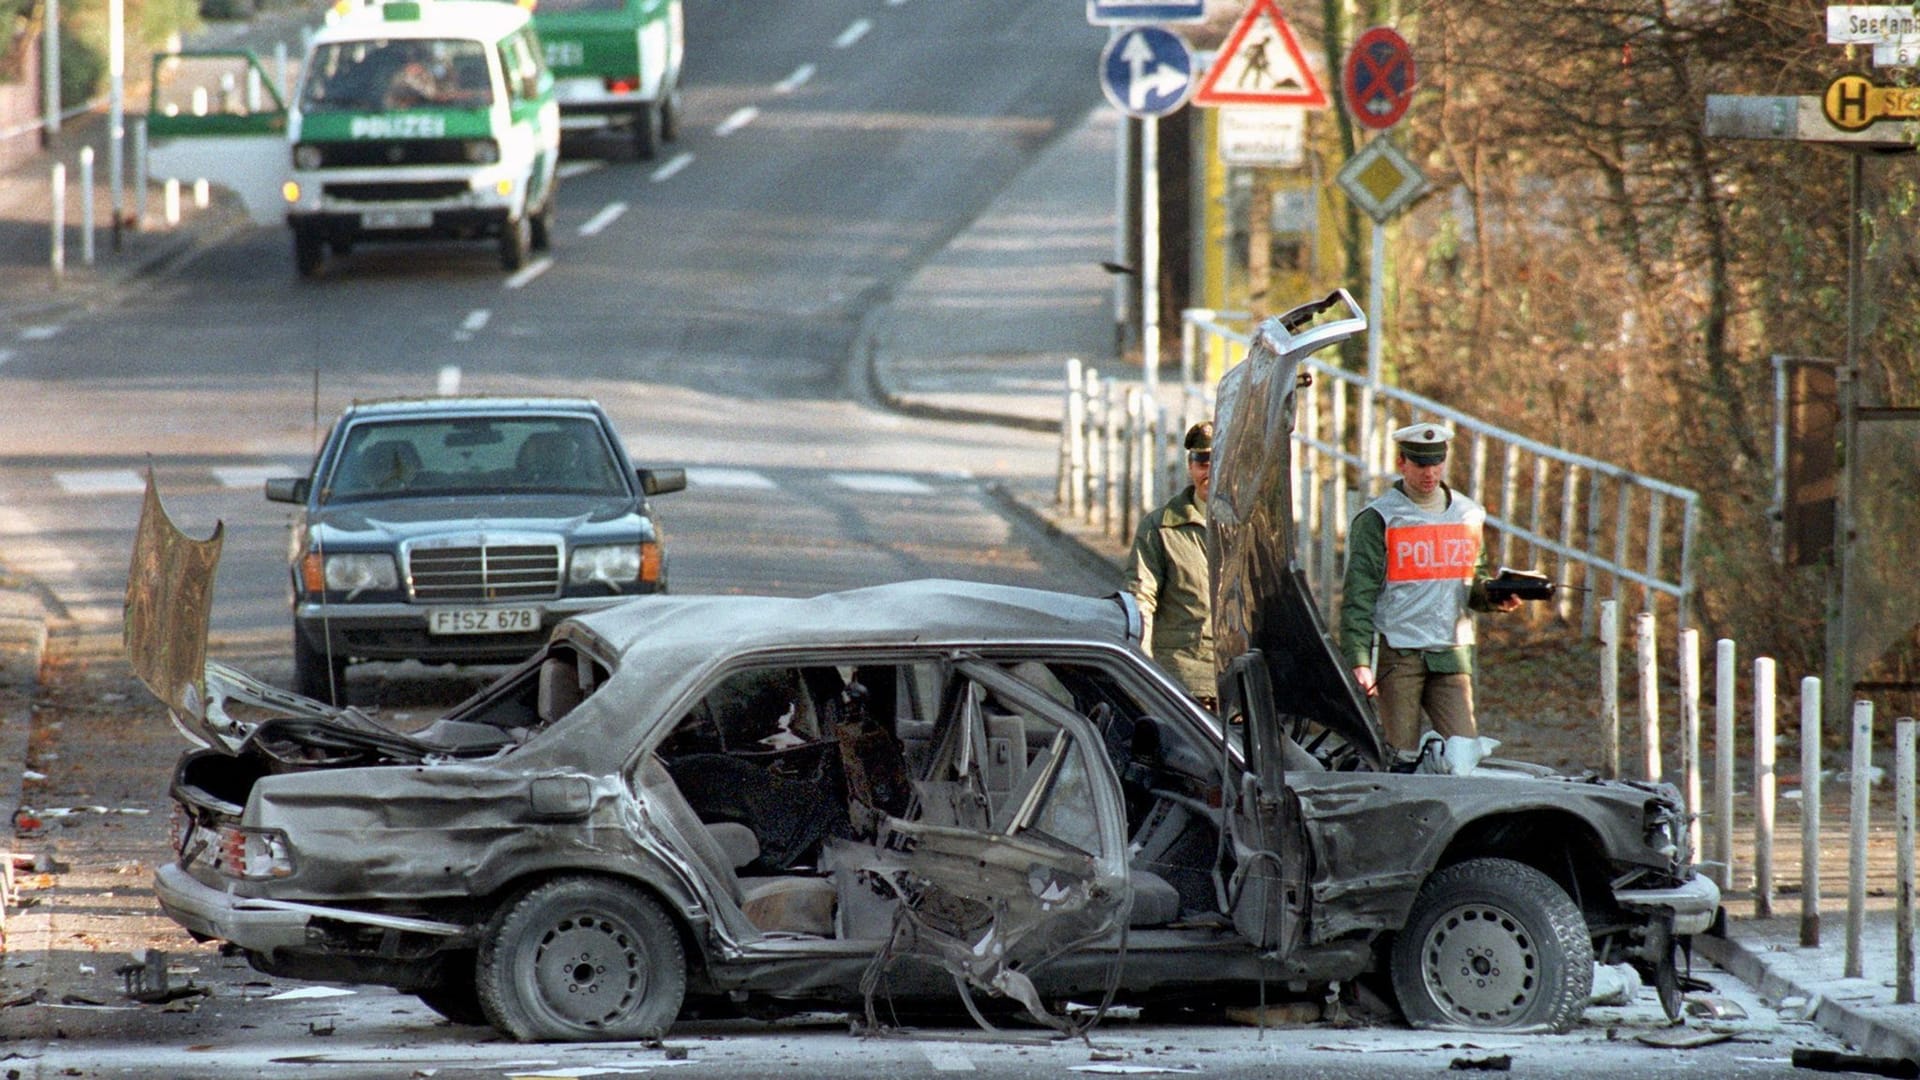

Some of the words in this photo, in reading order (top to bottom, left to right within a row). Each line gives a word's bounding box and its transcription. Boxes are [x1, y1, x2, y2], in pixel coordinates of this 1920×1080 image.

[1838, 82, 1866, 121] H
[352, 115, 445, 138] POLIZEI
[438, 612, 450, 629] F
[462, 611, 489, 629] SZ
[498, 610, 531, 629] 678
